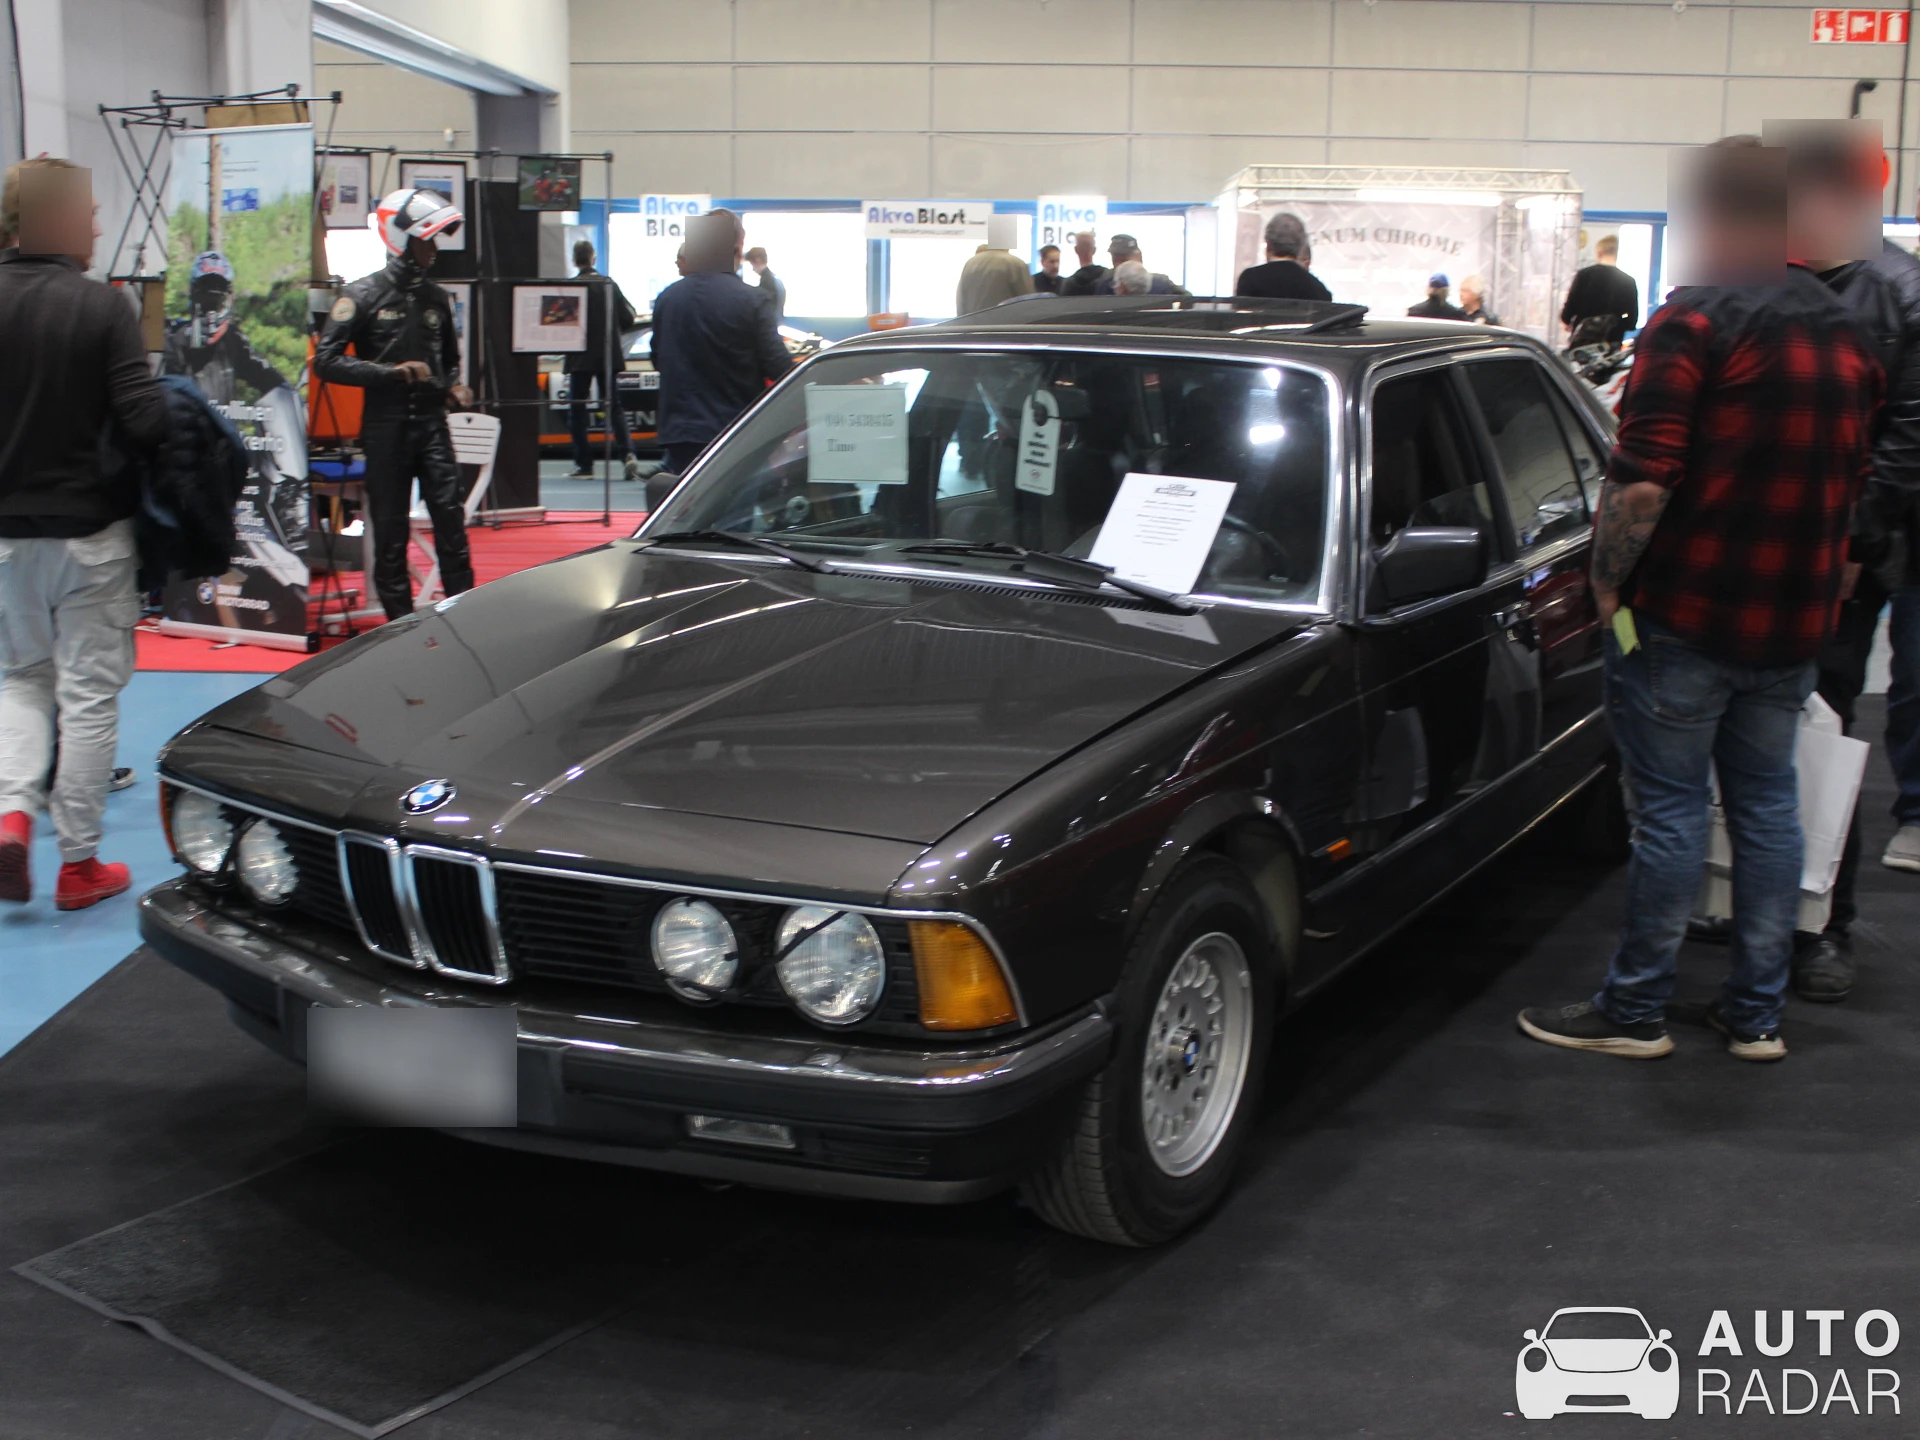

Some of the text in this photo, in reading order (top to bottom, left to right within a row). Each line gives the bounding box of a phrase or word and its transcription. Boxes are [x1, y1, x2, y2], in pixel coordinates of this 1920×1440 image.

[646, 196, 699, 215] Akva
[868, 206, 966, 224] AkvaBlast
[1043, 203, 1096, 222] Akva
[1307, 226, 1465, 256] GNUM CHROME
